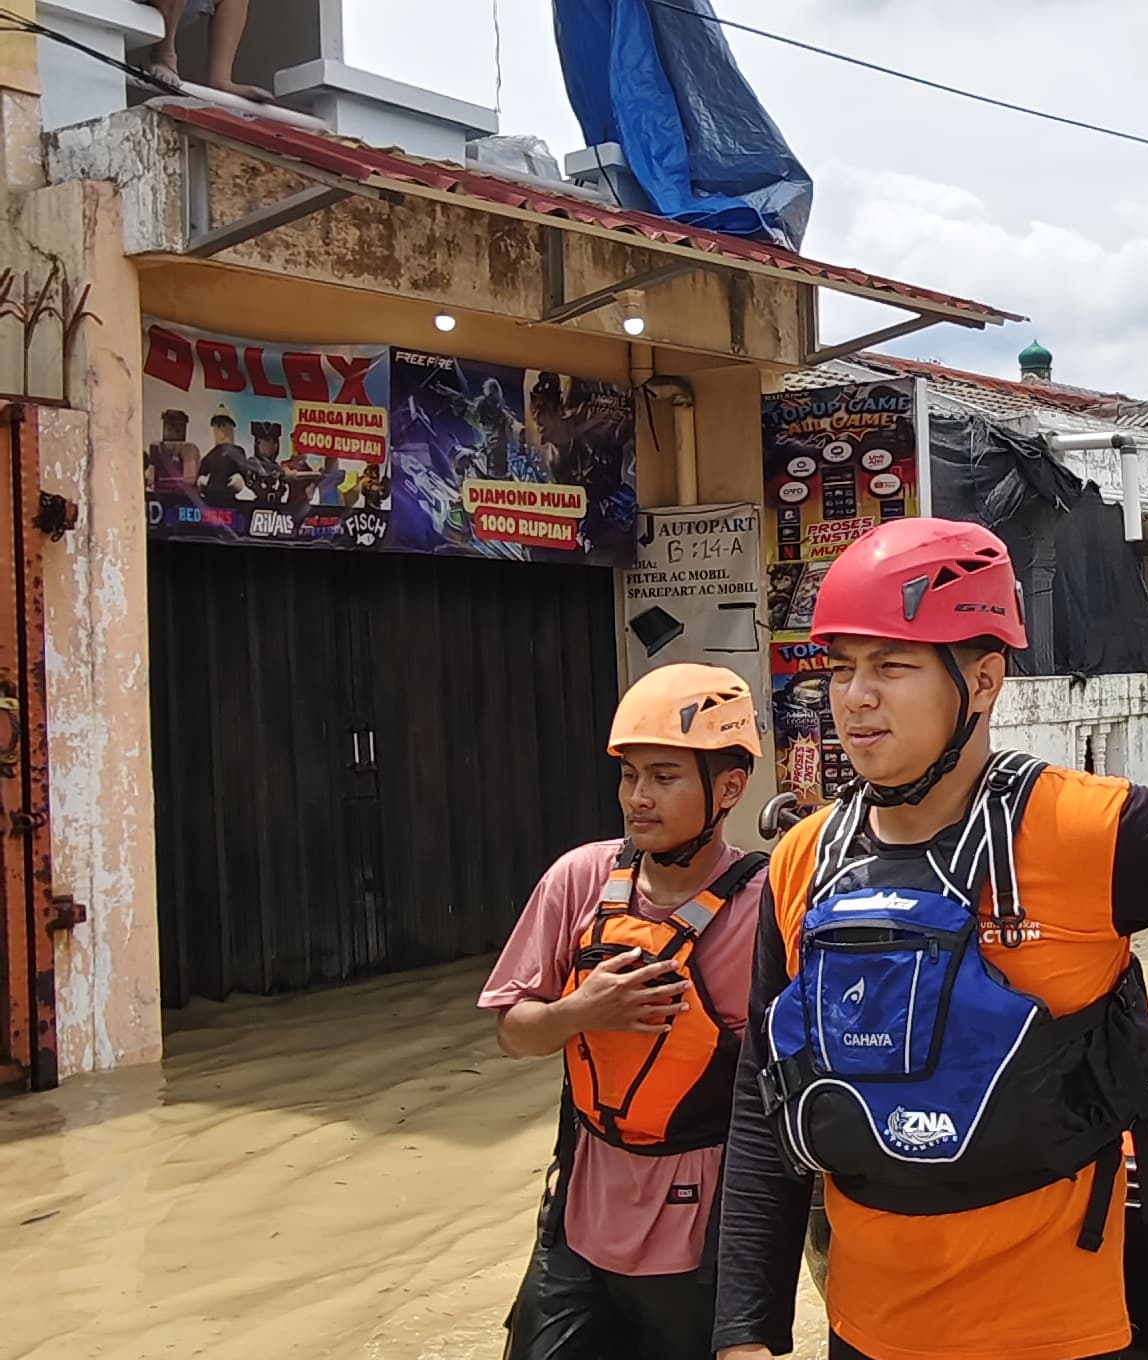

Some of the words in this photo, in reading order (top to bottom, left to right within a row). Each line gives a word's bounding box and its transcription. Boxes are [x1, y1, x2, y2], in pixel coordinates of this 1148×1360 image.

[396, 351, 426, 367] FREE
[770, 402, 841, 423] TOPUP
[848, 392, 911, 412] GAME
[299, 407, 344, 425] HARGA
[345, 411, 383, 428] MULAI
[830, 413, 895, 430] GAME
[299, 430, 333, 450] 4000
[334, 436, 381, 457] RUPIAH
[468, 487, 538, 507] DIAMOND
[540, 491, 581, 509] MULAI
[345, 512, 387, 538] FISCH
[480, 514, 516, 534] 1000
[518, 518, 572, 541] RUPIAH
[658, 517, 756, 537] AUTOPART
[807, 517, 873, 536] PROSES
[810, 544, 848, 557] MUR
[636, 560, 657, 569] DIA:
[627, 572, 667, 584] FILTER
[670, 571, 686, 581] AC
[688, 569, 730, 580] MOBIL
[627, 585, 697, 599] SPAREPART
[698, 584, 715, 595] AC
[717, 582, 758, 595] MOBIL
[779, 643, 830, 660] TOP
[798, 656, 831, 672] ALL
[793, 746, 805, 783] PROSES
[804, 747, 816, 783] INSTAN
[843, 1033, 893, 1047] CAHAYA
[903, 1111, 957, 1135] ZNA
